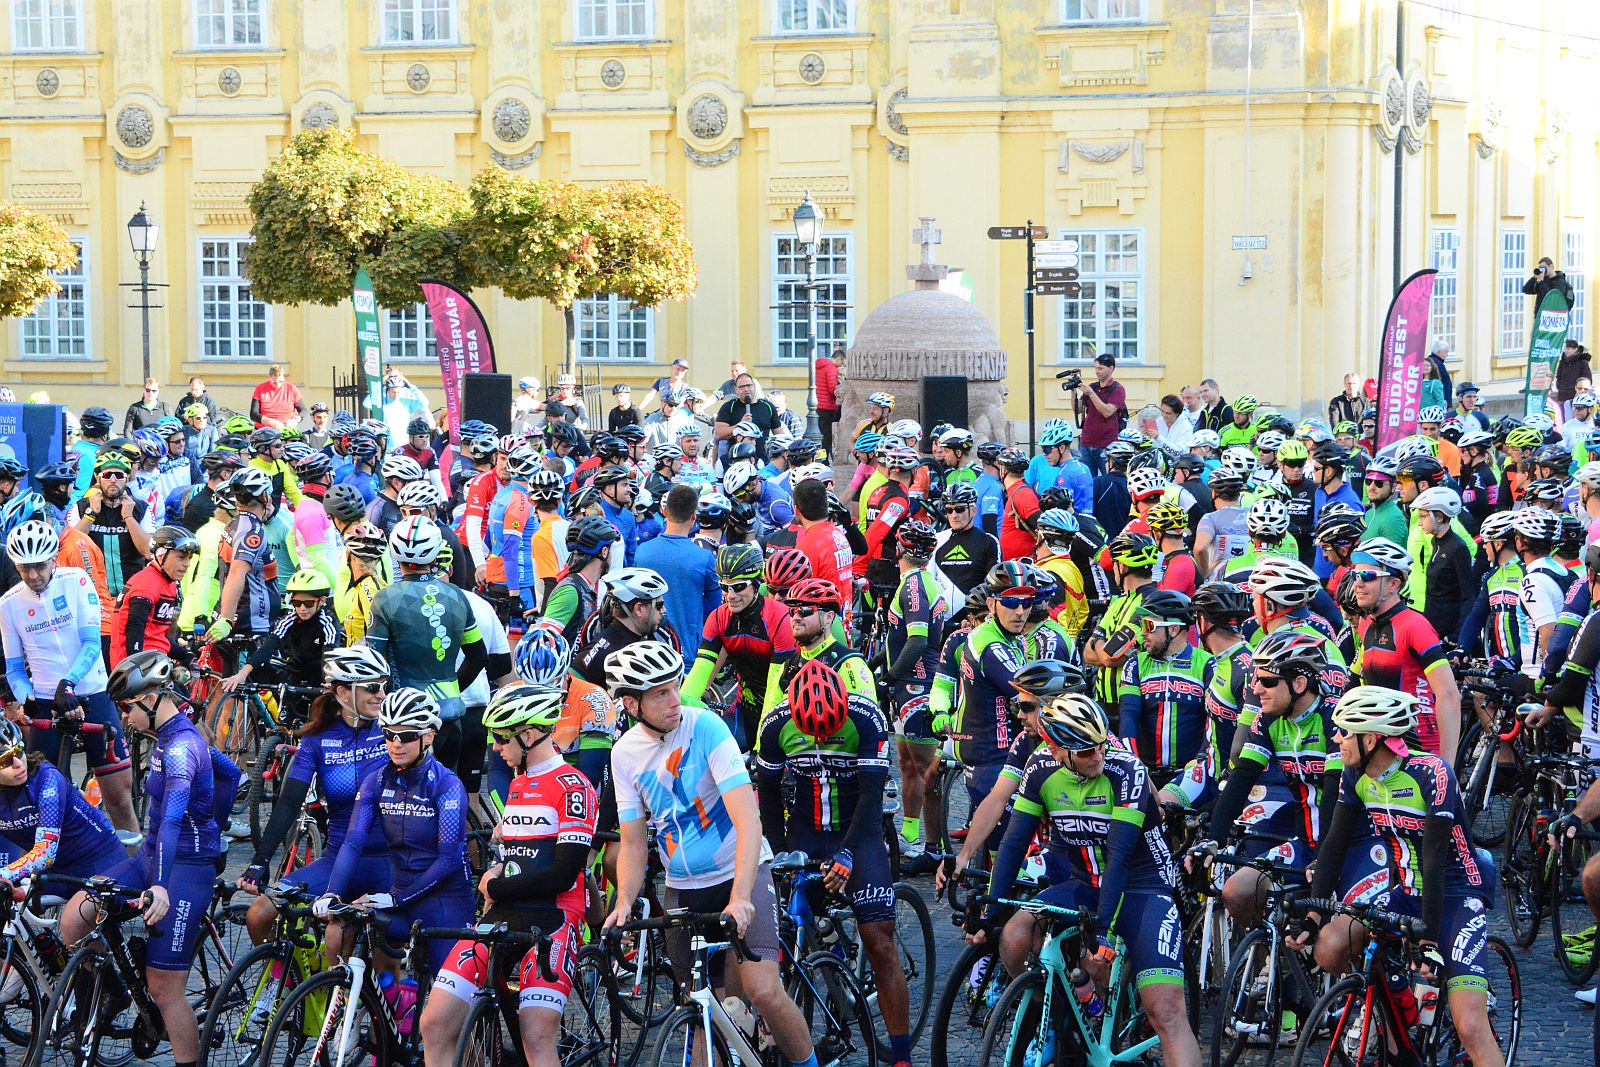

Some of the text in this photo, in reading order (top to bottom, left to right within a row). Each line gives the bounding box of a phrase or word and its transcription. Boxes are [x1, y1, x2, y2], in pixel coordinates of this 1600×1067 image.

[1388, 314, 1408, 427] BUDAPEST
[1402, 365, 1420, 422] GYŐR
[1140, 680, 1204, 697] SZINGO
[1144, 828, 1163, 863] Balaton
[1452, 824, 1482, 886] SZINGO
[171, 899, 188, 952] FEHÉRVÁR
[177, 901, 192, 952] CYCLING TEAM
